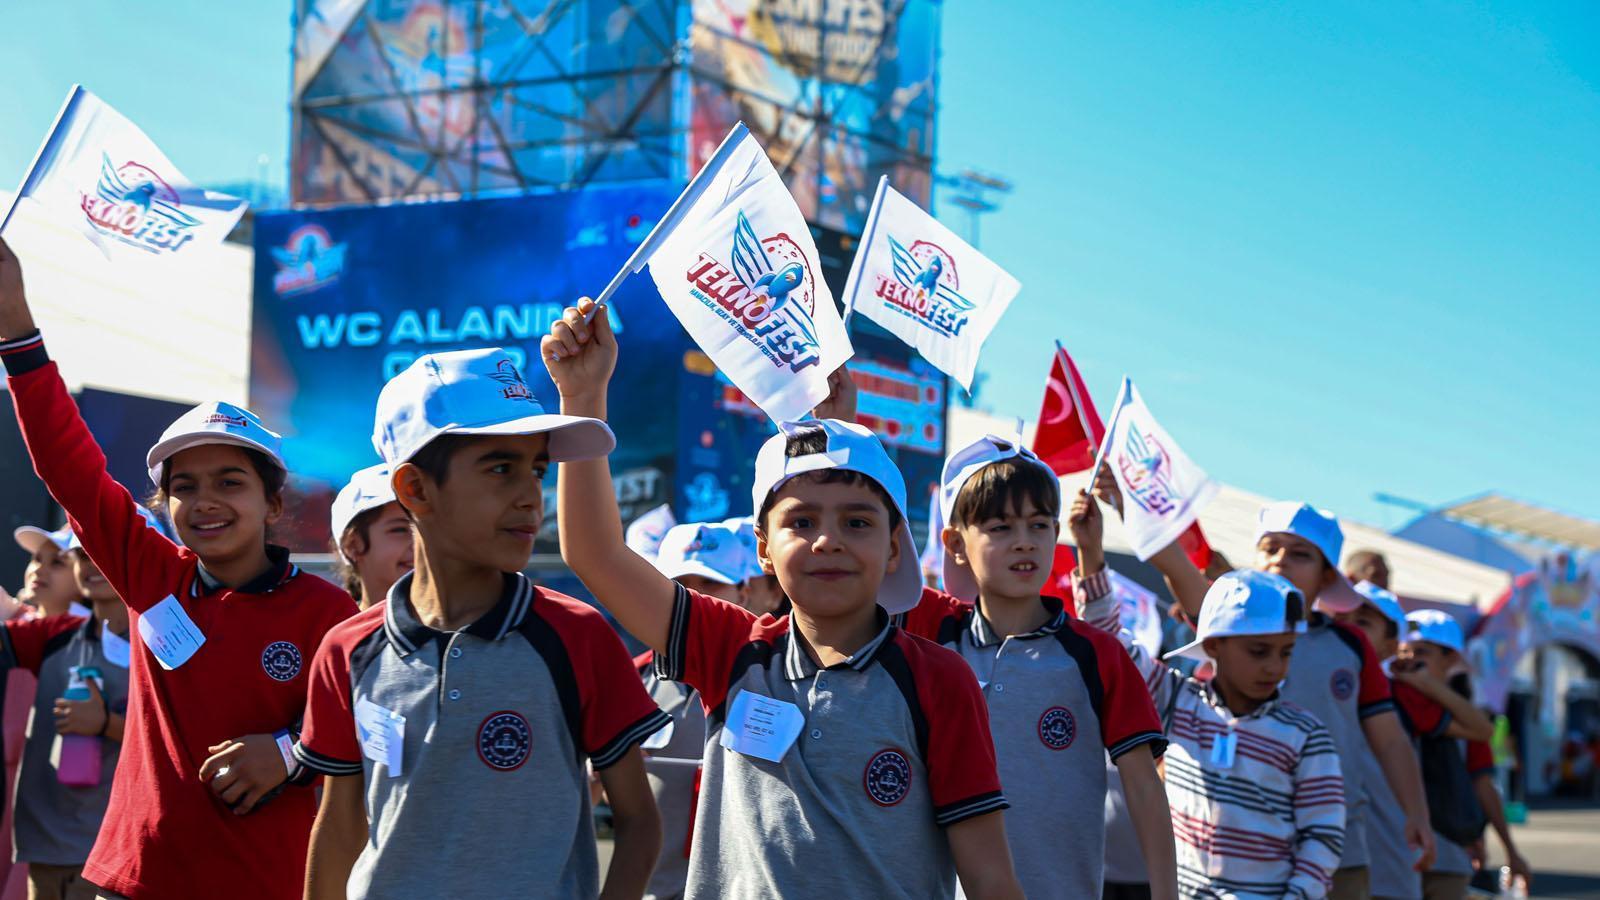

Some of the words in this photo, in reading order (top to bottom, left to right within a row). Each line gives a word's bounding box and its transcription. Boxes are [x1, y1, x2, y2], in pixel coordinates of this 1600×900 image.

[297, 312, 382, 348] WC
[687, 252, 820, 373] TEKNOFEST
[875, 274, 968, 336] TEKNOFEST
